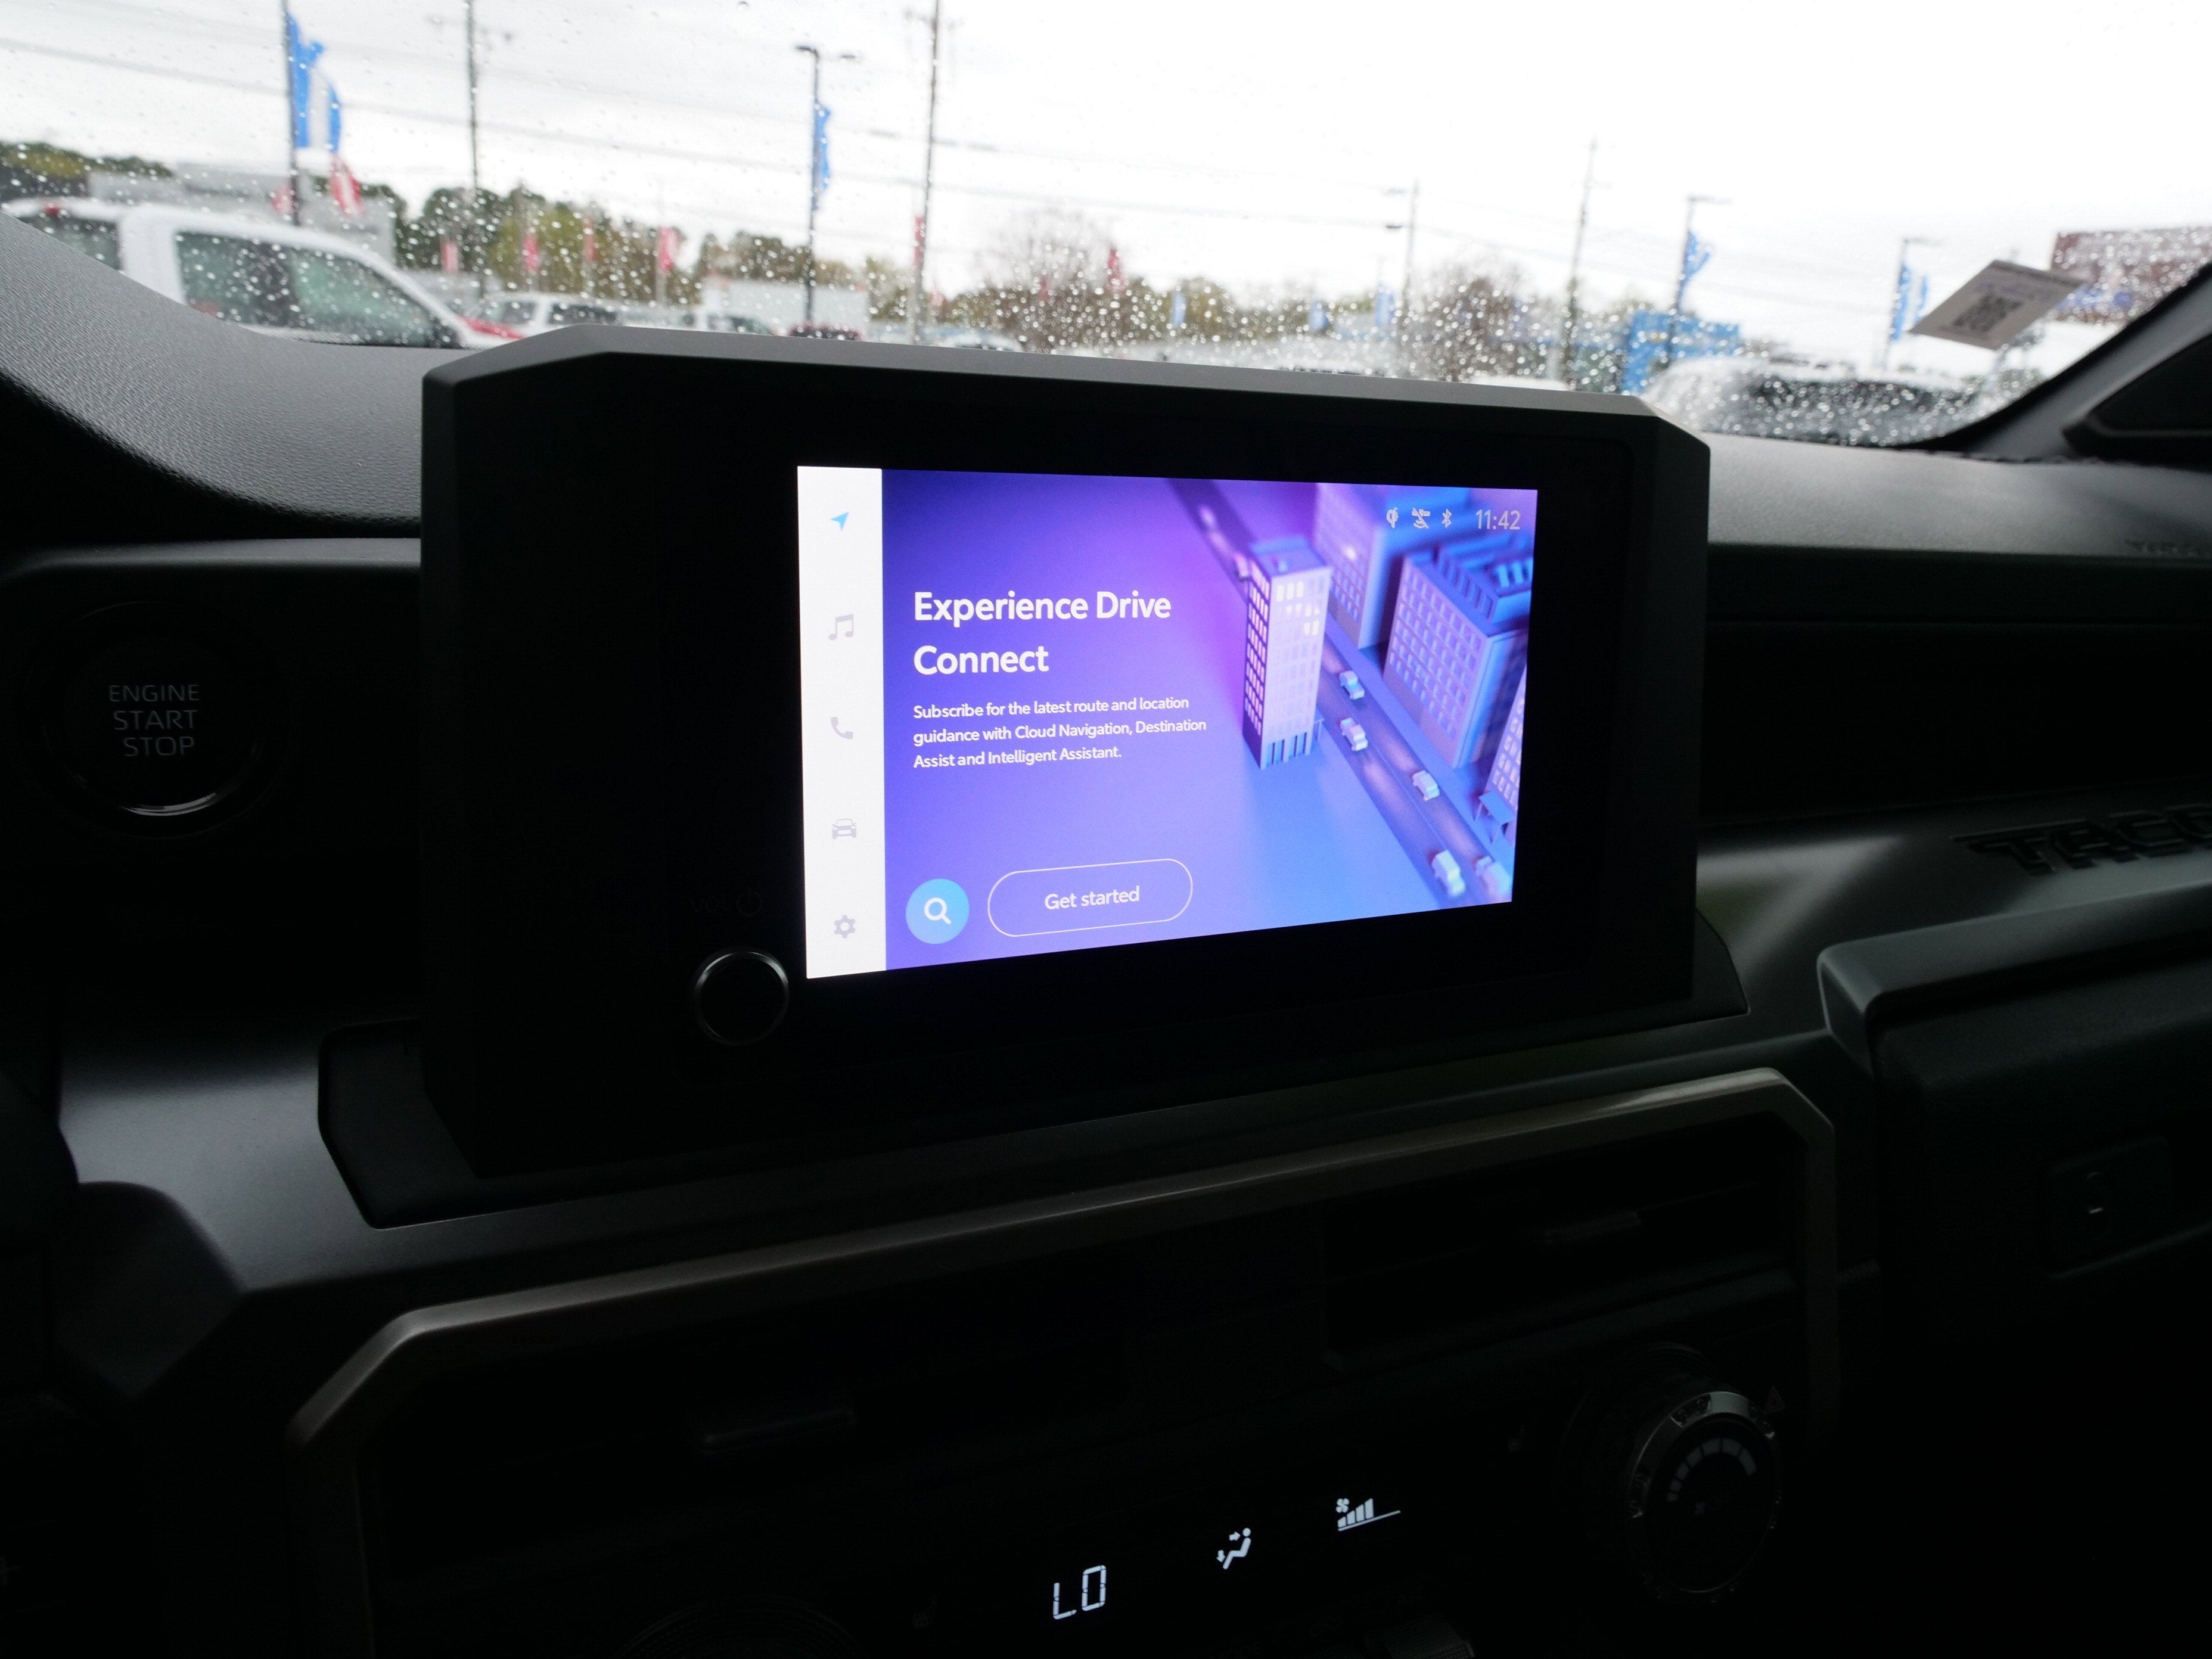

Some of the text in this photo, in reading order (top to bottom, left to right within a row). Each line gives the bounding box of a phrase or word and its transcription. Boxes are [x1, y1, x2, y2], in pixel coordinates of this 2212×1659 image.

[1475, 509, 1521, 530] 11:42
[914, 589, 1171, 627] Experience Drive
[914, 645, 1049, 675] Connect
[109, 684, 200, 702] ENGINE
[113, 709, 198, 730] START
[914, 697, 1189, 719] Subscribe for the latest route and location
[914, 719, 1207, 747] guidance with Cloud Navigation, Destination
[123, 735, 195, 757] STOP
[914, 745, 1121, 769] Assist and Intelligent Assistant.
[1044, 885, 1140, 909] Get started
